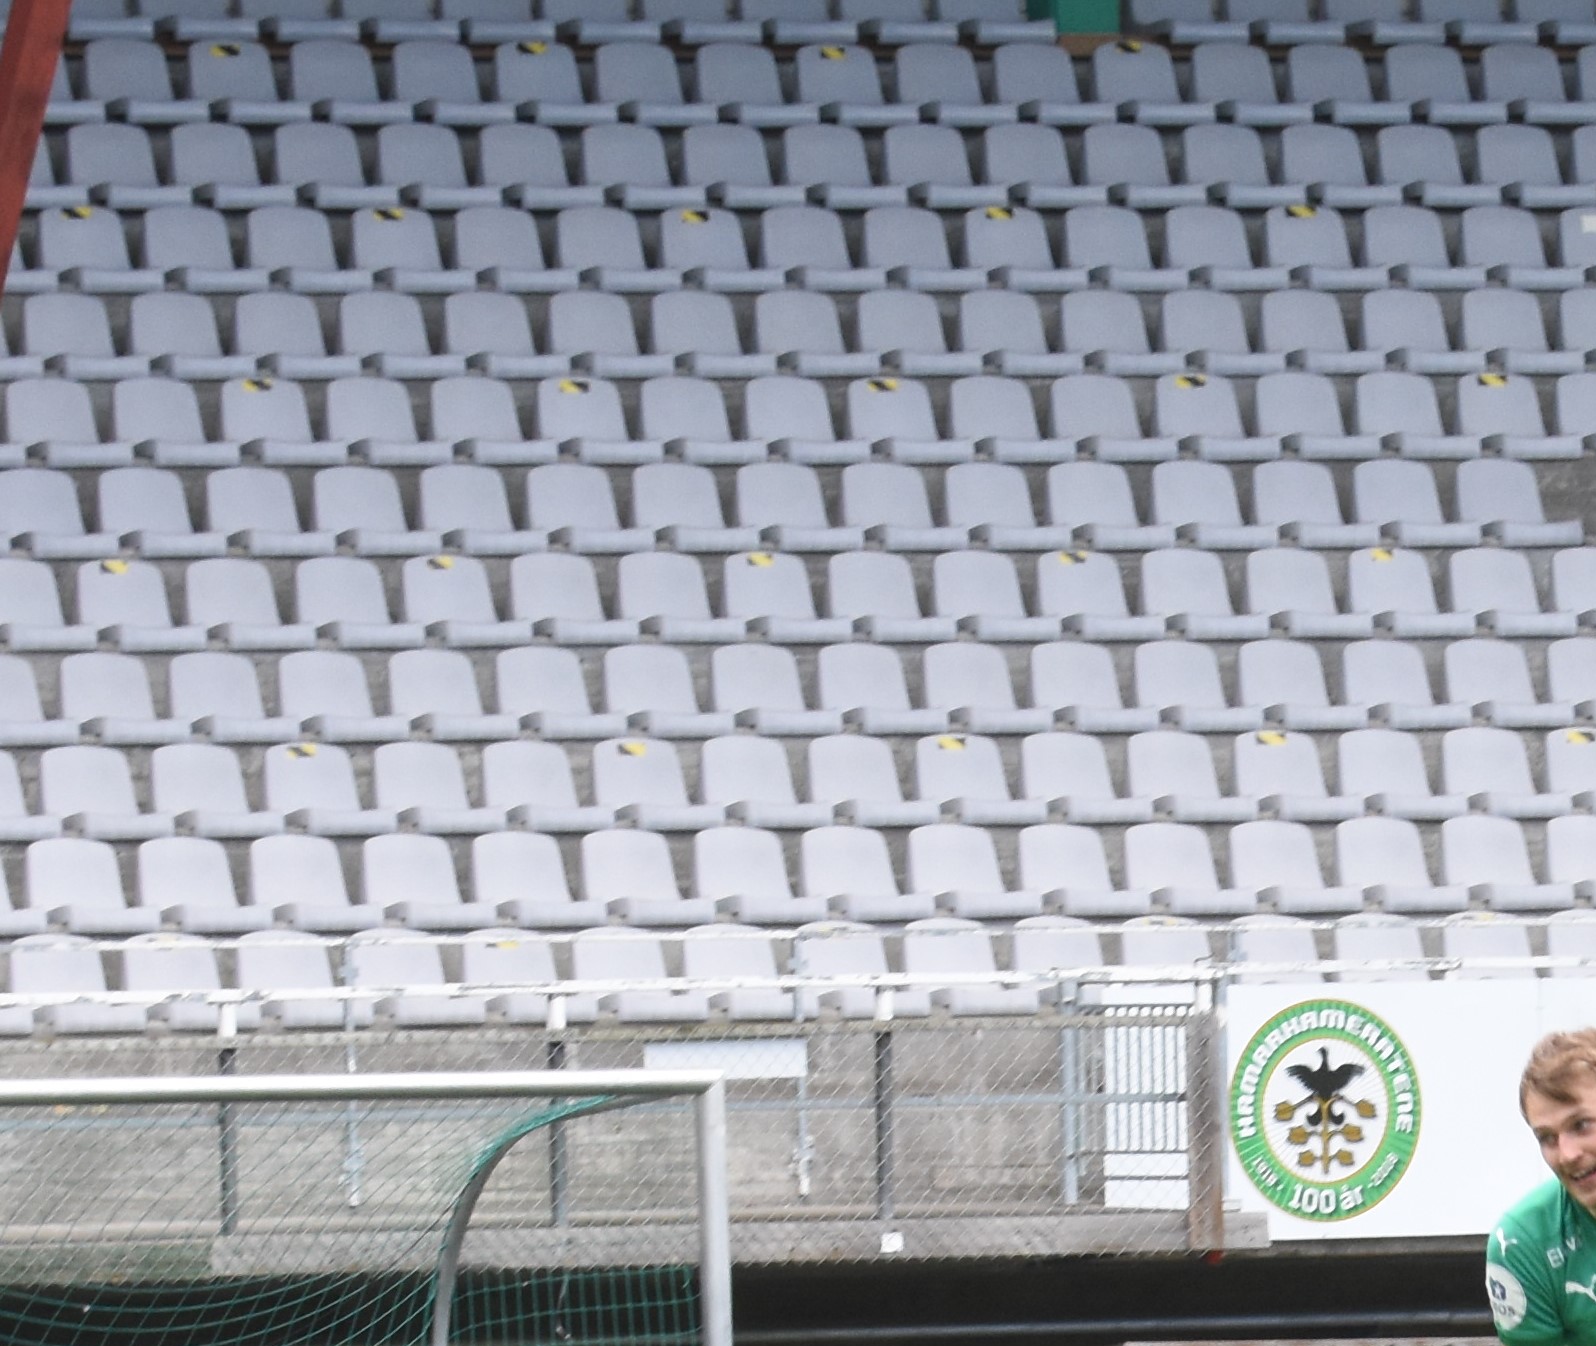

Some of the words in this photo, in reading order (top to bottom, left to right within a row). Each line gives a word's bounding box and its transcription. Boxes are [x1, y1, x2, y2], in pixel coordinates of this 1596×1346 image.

[1236, 1008, 1414, 1138] HAMARKAMERATENE
[1288, 1184, 1336, 1214] 100
[1340, 1184, 1364, 1211] år
